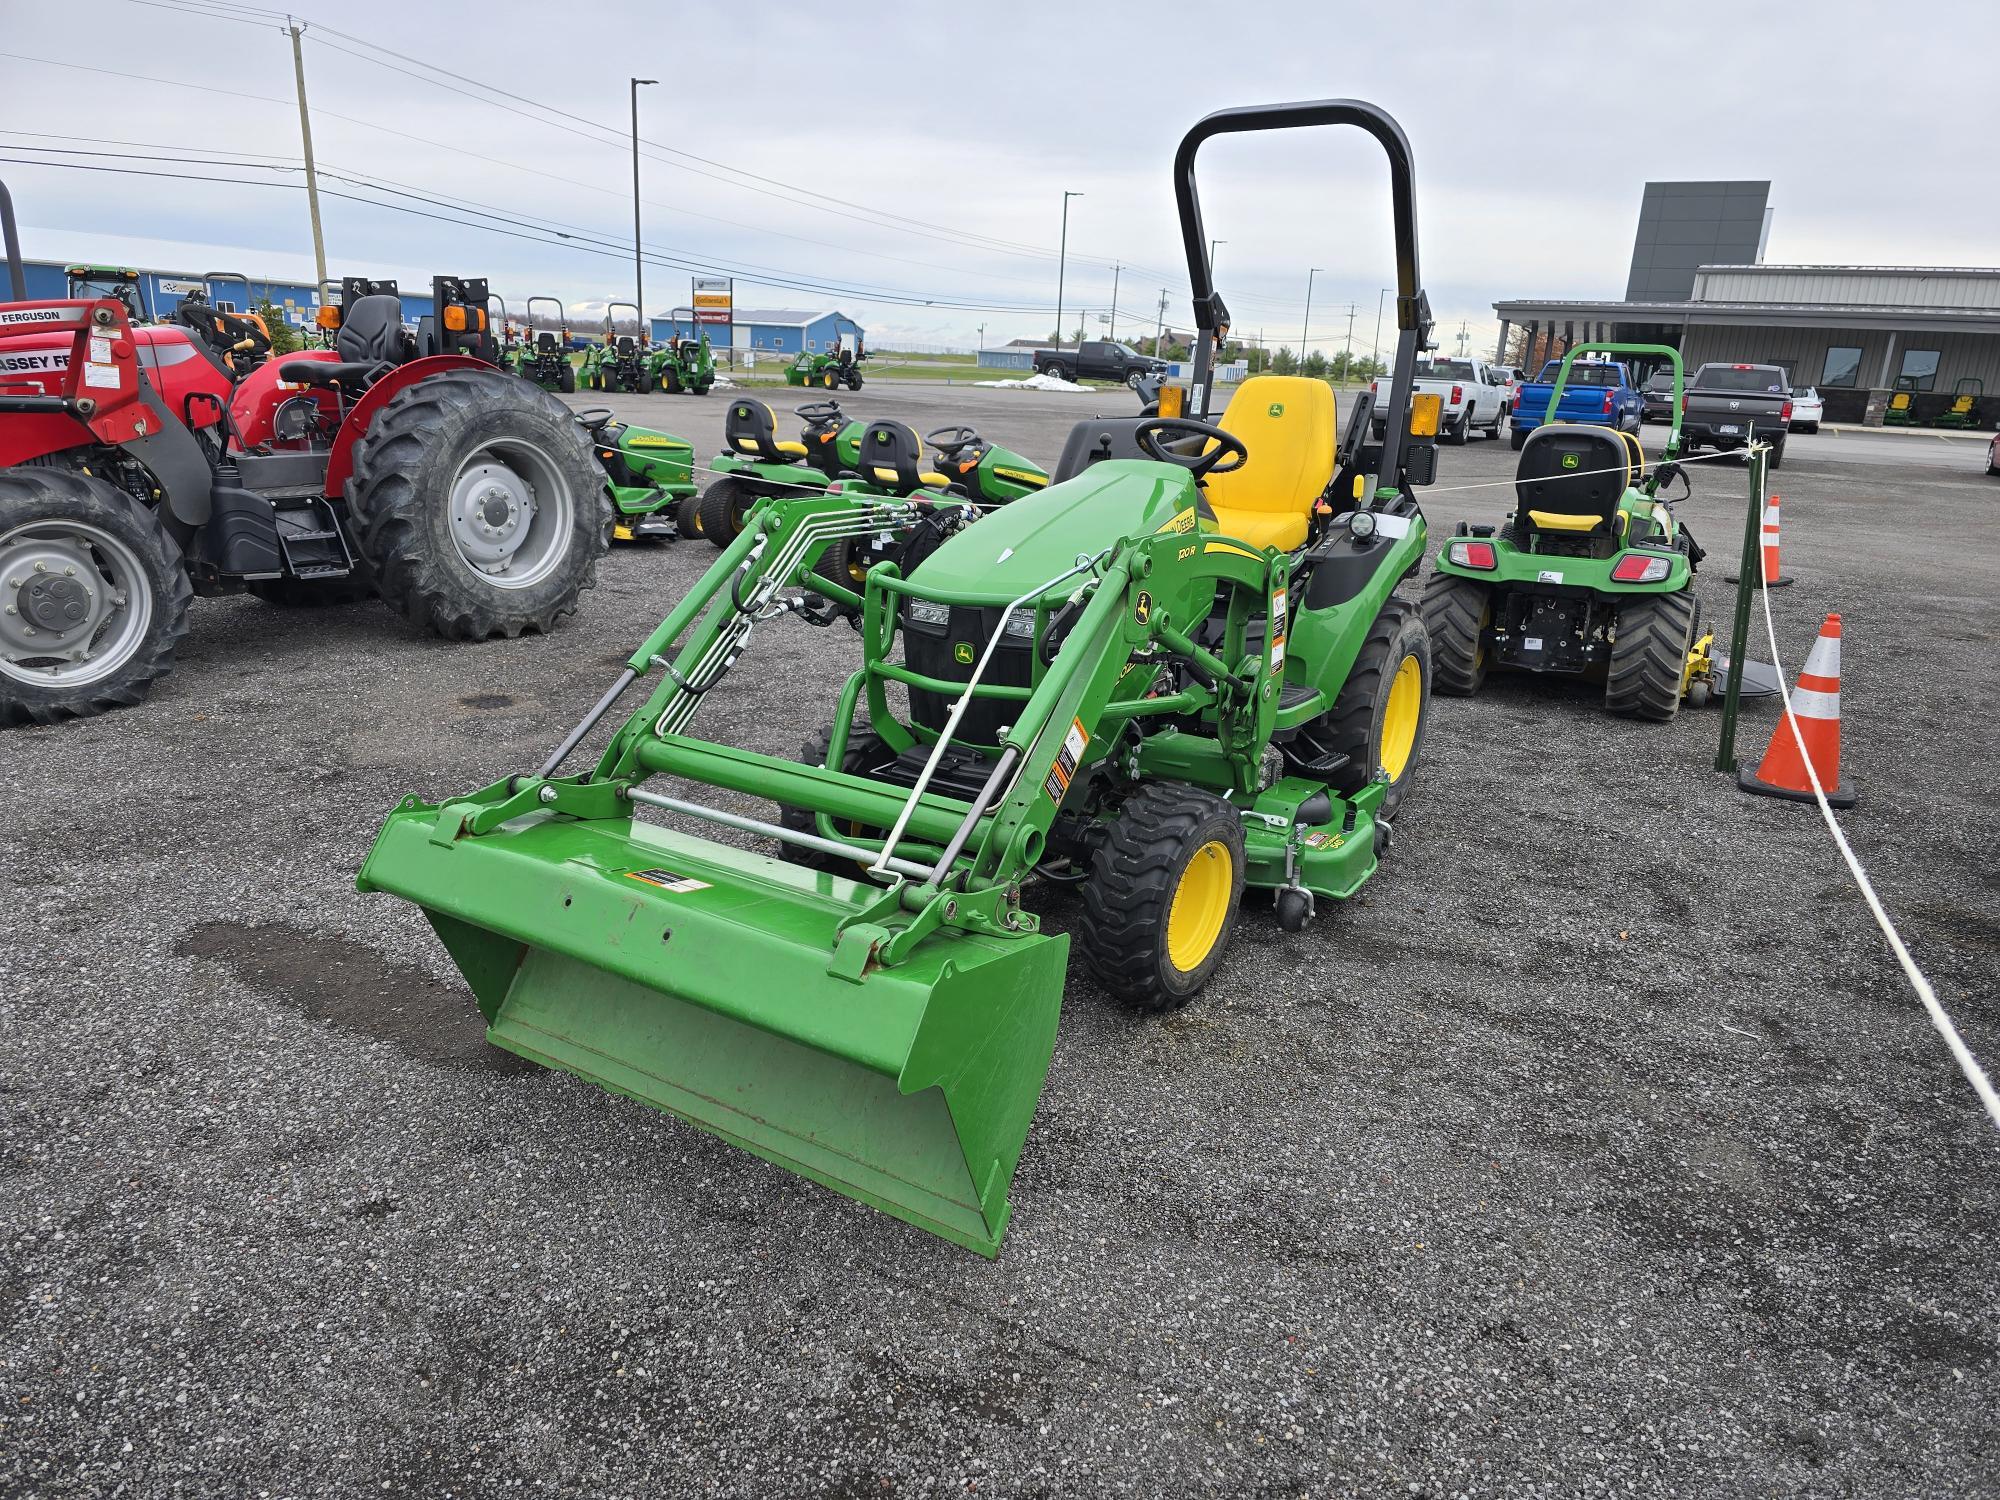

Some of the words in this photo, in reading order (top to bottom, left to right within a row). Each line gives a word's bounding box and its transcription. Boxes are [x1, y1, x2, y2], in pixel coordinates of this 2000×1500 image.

[1, 311, 60, 323] FERGUSON
[0, 355, 48, 371] ASSEY
[1176, 514, 1194, 533] DEERE
